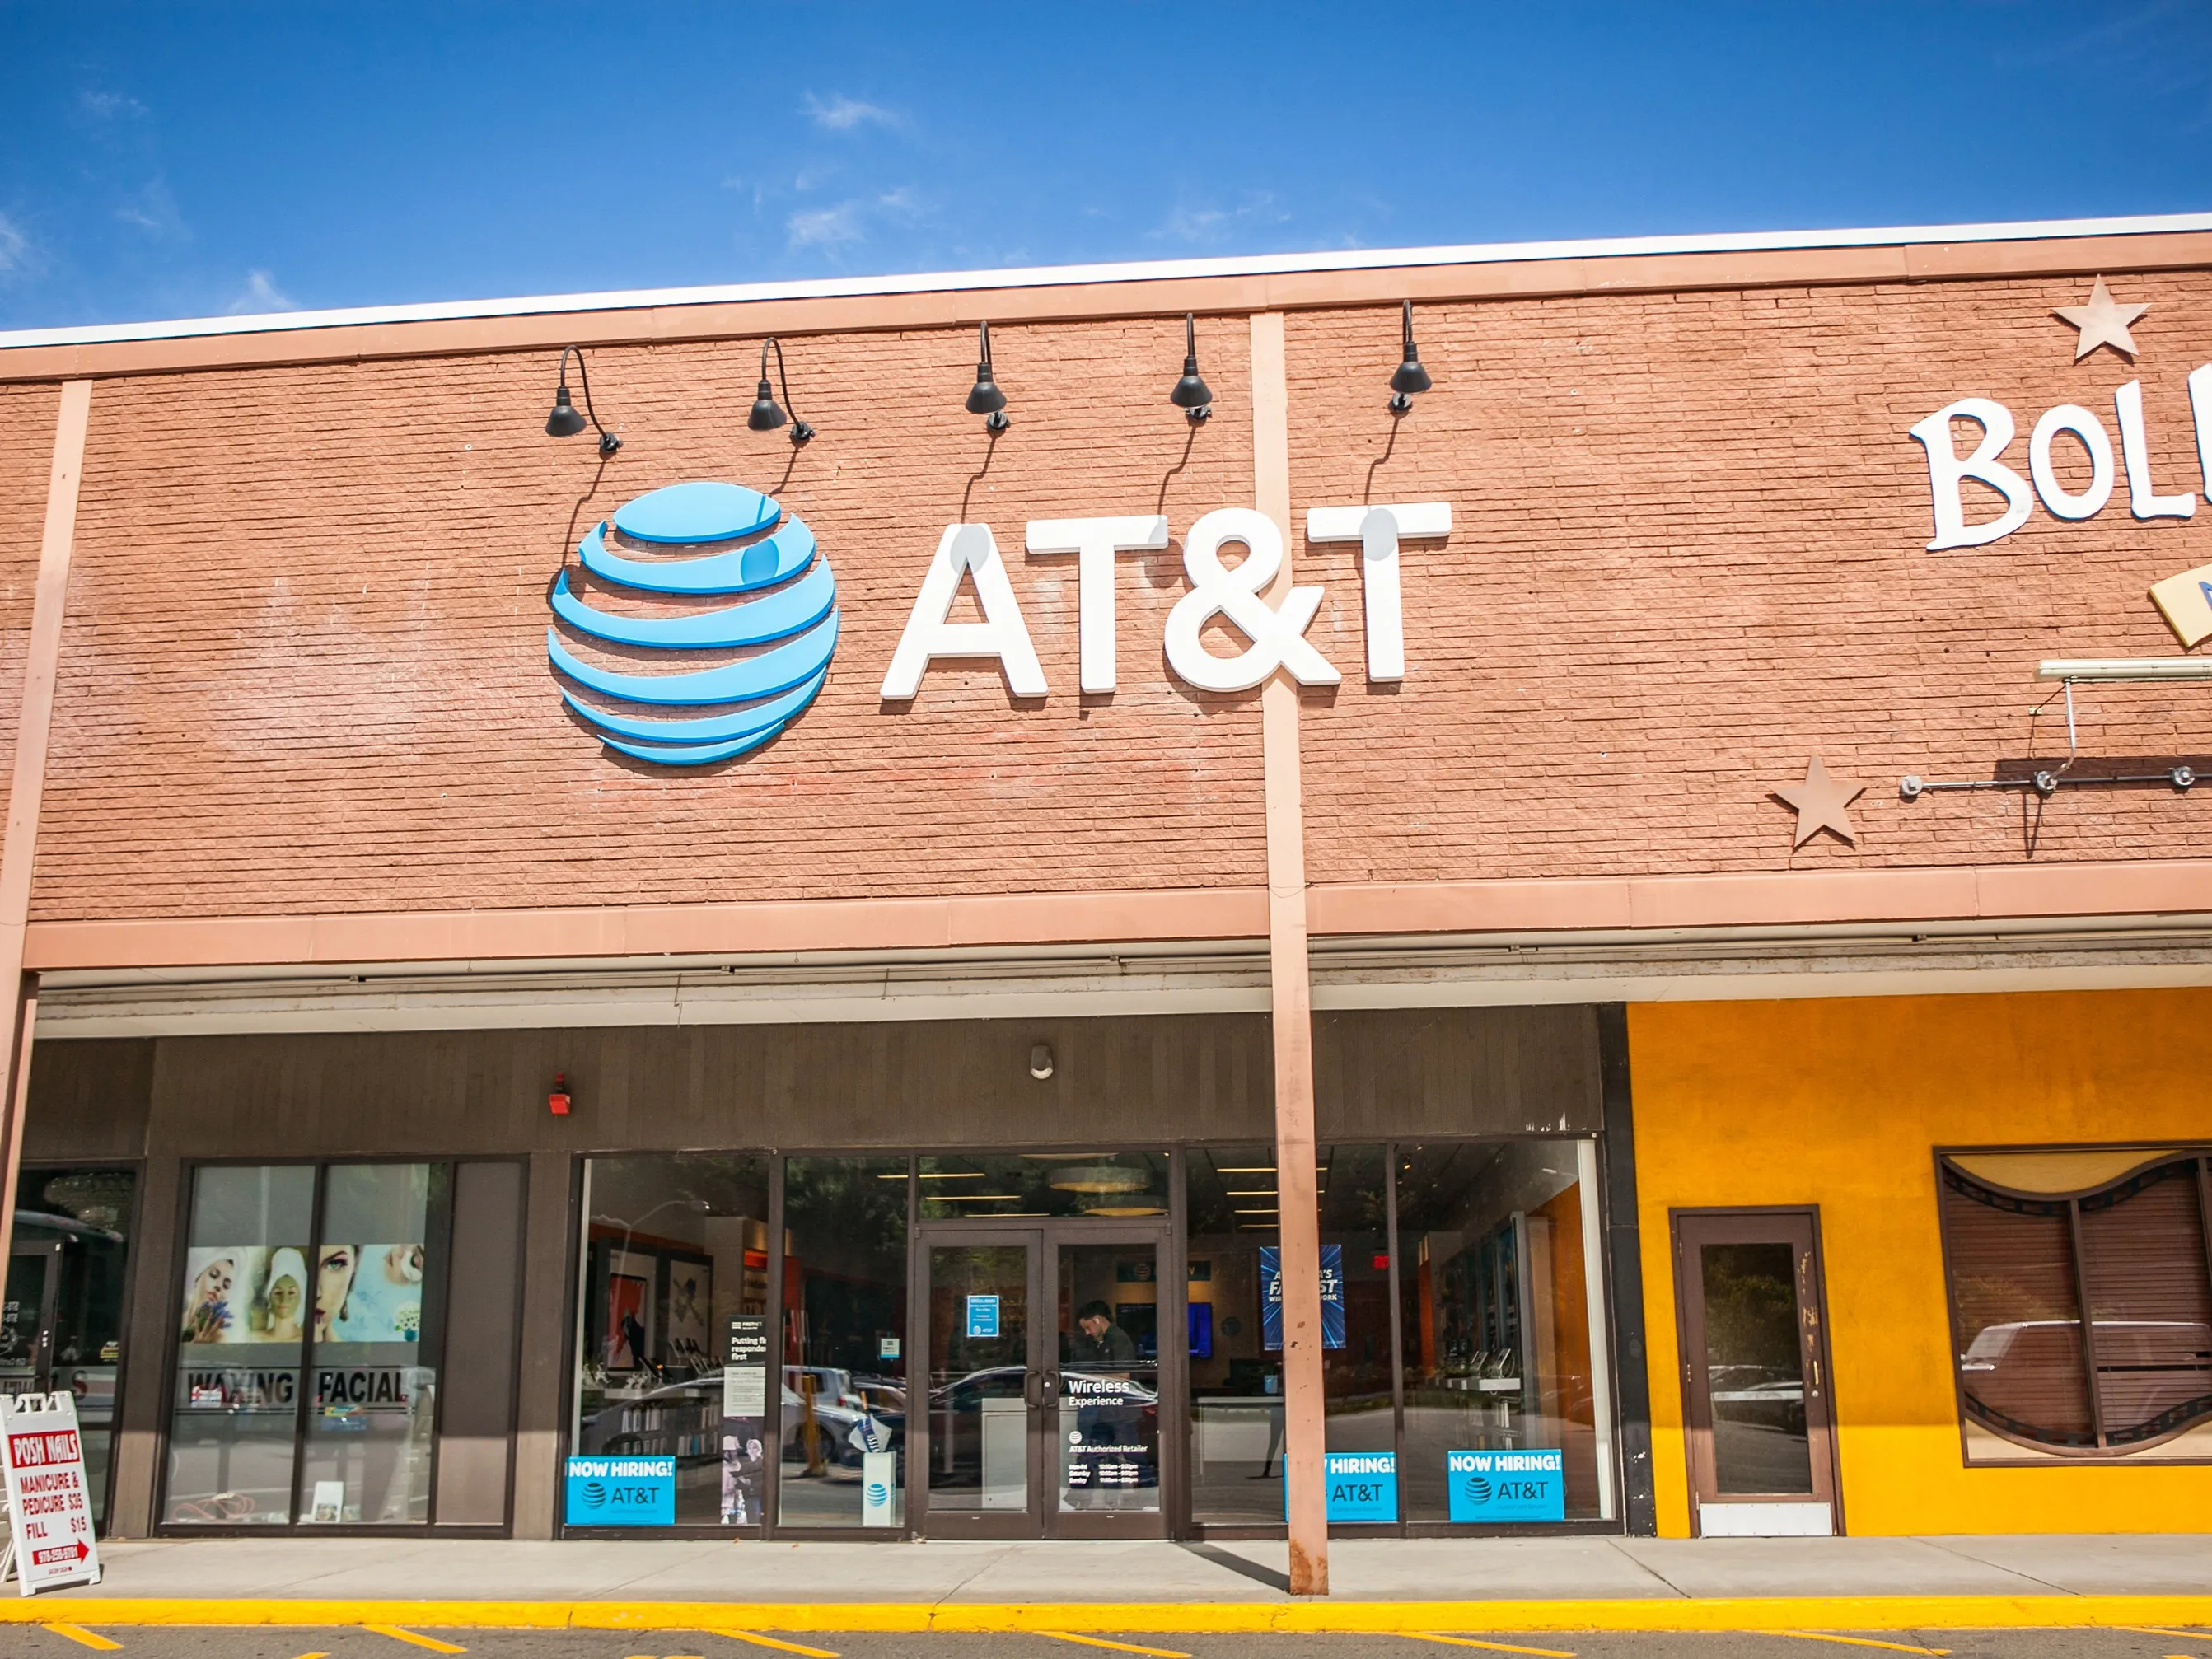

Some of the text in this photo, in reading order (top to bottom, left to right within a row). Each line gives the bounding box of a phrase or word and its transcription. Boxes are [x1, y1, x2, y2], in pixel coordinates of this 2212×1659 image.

[879, 502, 1452, 700] AT&T
[731, 1337, 758, 1345] Putting
[319, 1371, 408, 1403] FACIAL
[1069, 1379, 1129, 1393] Wireless
[1069, 1396, 1124, 1408] Experience
[14, 1432, 79, 1465] POSH NAILS
[1123, 1444, 1148, 1452] Retailer
[569, 1461, 673, 1477] NOW HIRING!
[1330, 1457, 1396, 1474] HIRING!
[1450, 1455, 1561, 1472] NOW HIRING!
[20, 1471, 79, 1494] MANICURE &
[1497, 1482, 1548, 1499] AT&T
[610, 1487, 660, 1504] AT&T
[1332, 1484, 1383, 1502] AT&T
[22, 1495, 65, 1516] PEDICURE
[26, 1516, 87, 1540] FILL $15
